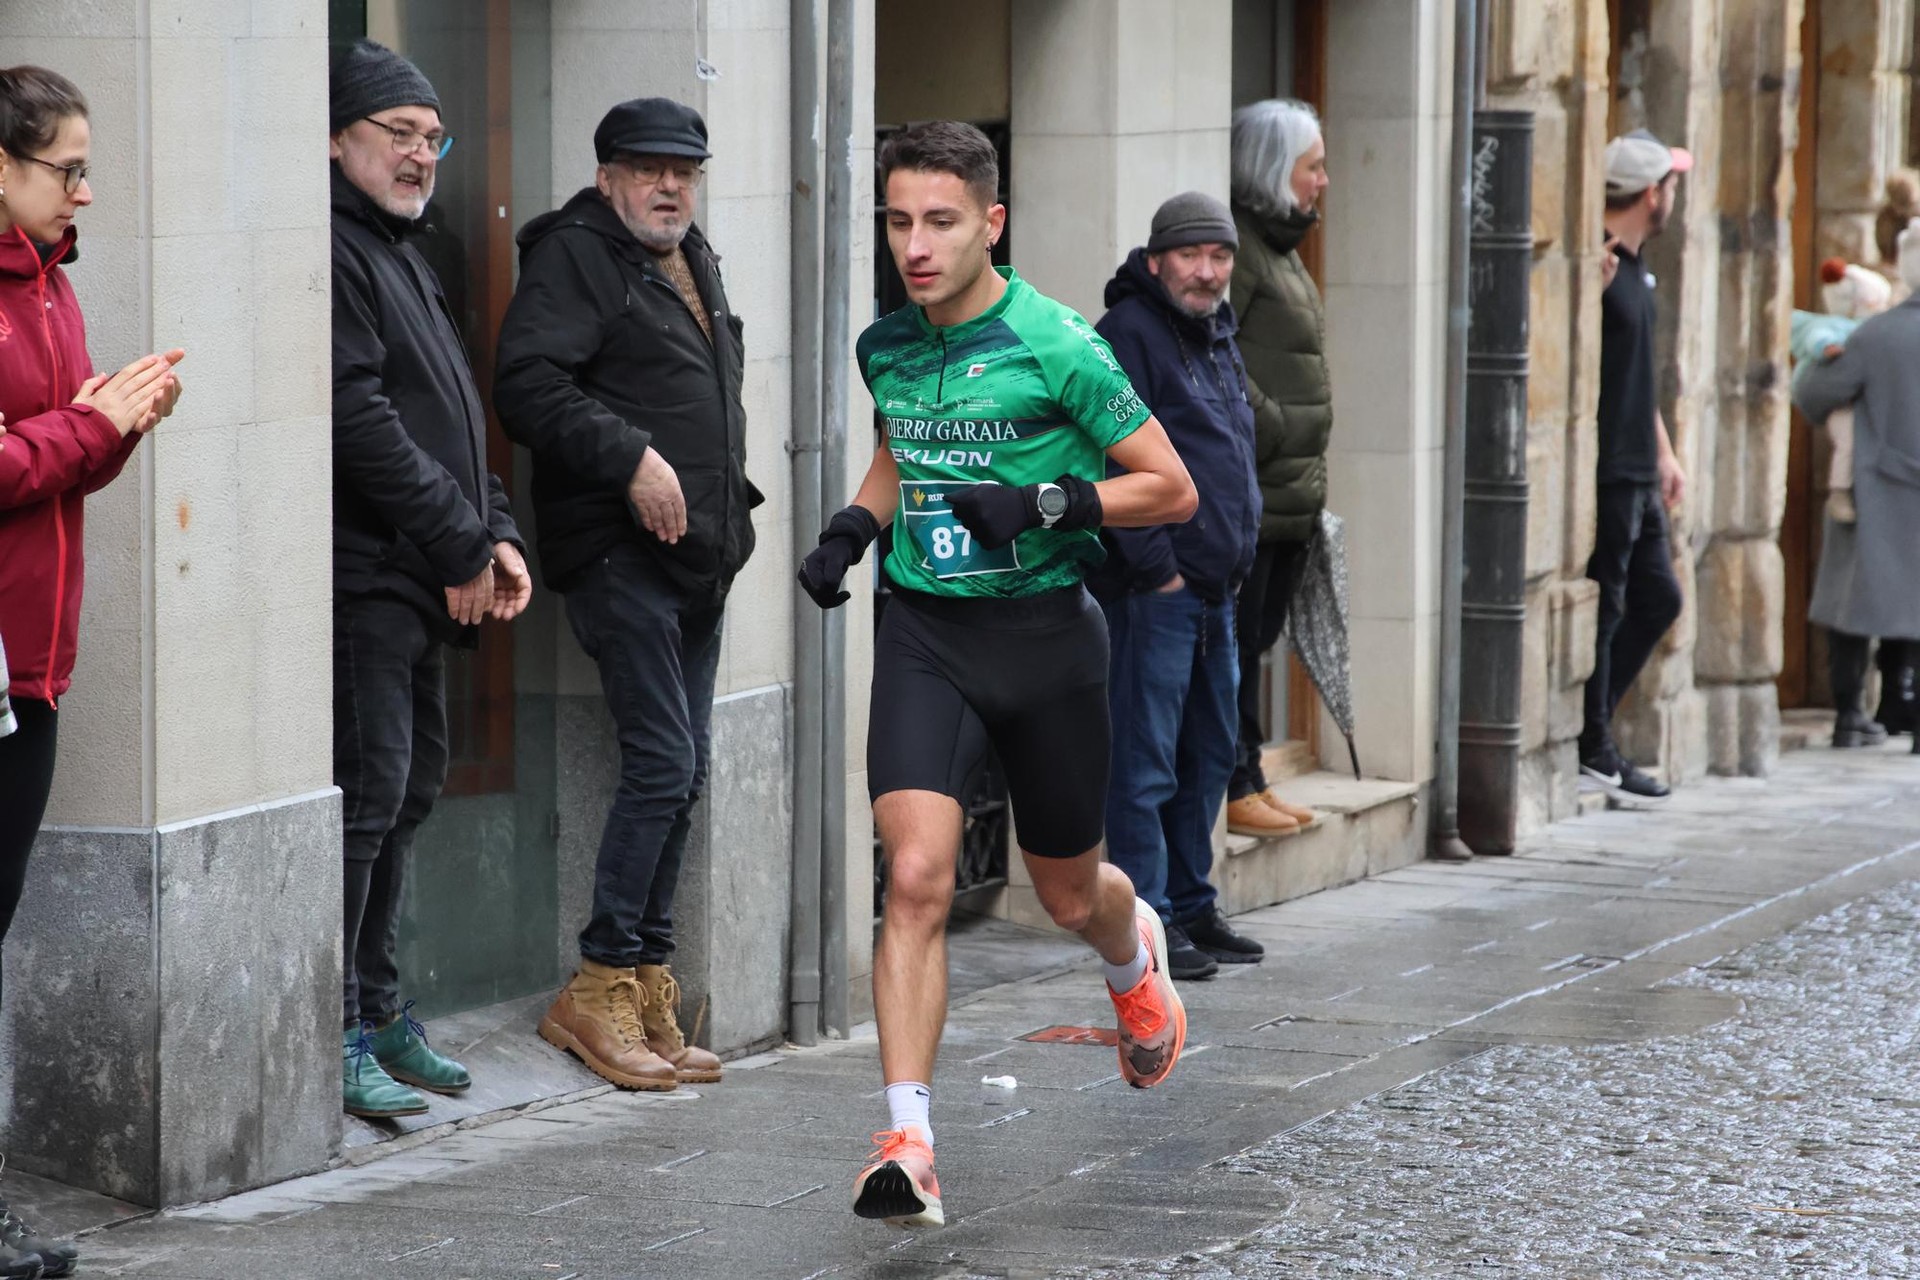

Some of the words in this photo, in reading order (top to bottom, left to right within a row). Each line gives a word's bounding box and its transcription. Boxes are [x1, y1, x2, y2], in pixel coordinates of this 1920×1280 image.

[886, 416, 934, 441] OIERRI
[936, 420, 1019, 441] GARAIA
[890, 447, 993, 467] EKUON
[931, 524, 971, 560] 87
